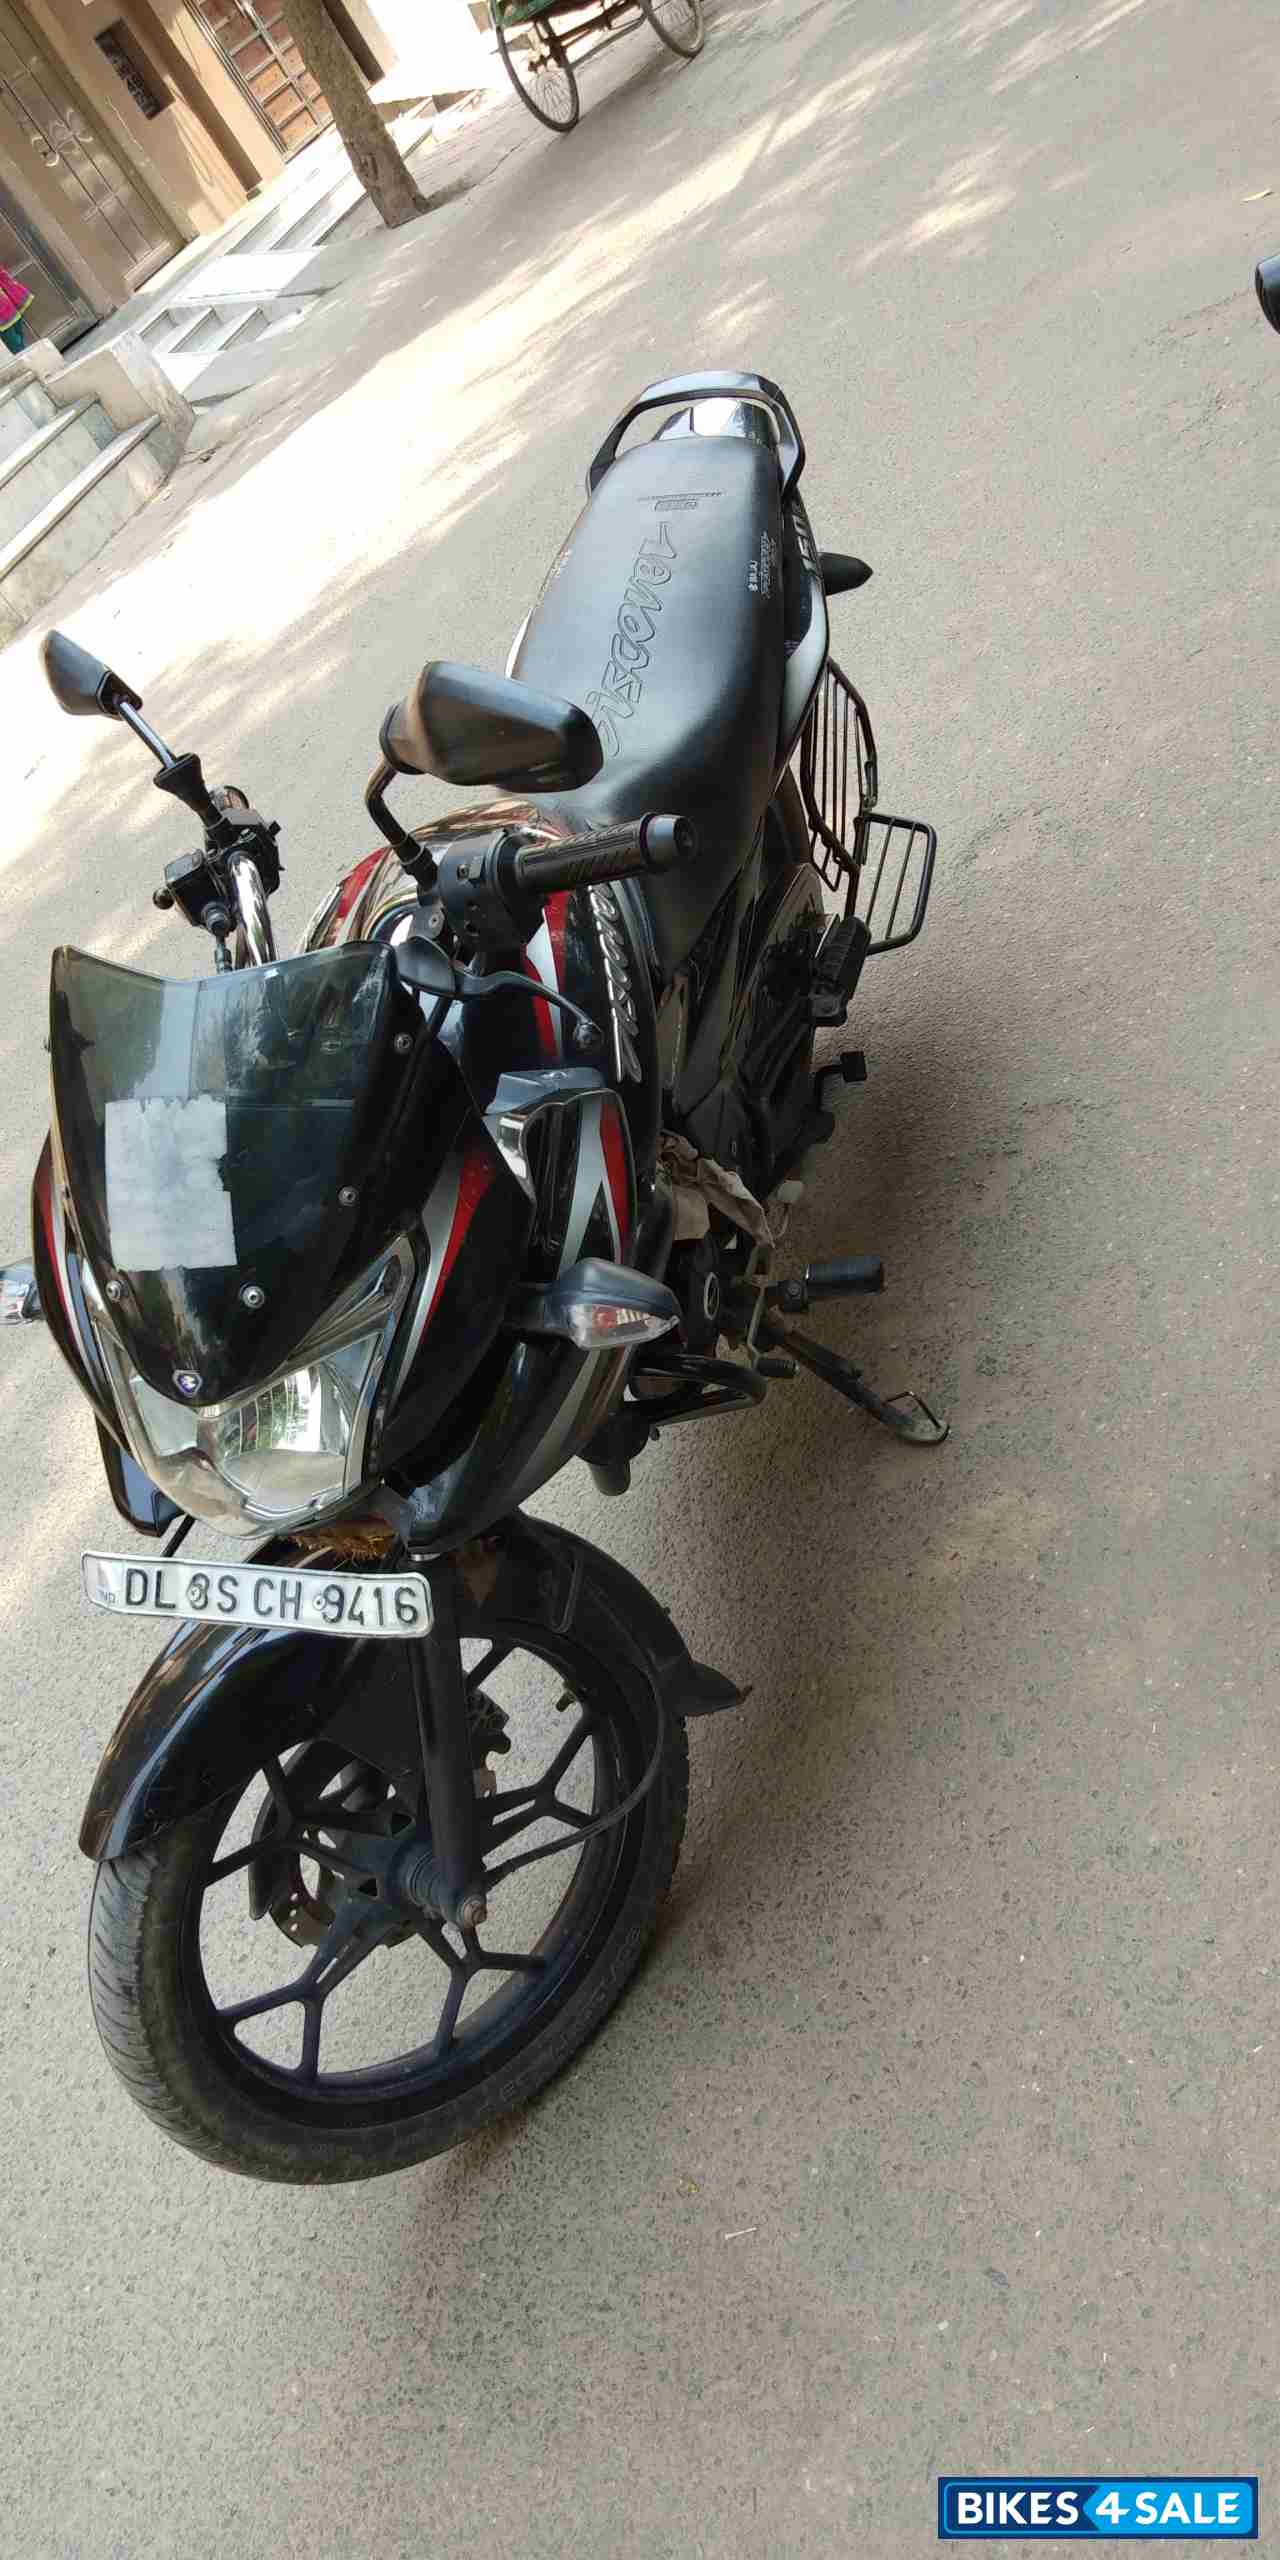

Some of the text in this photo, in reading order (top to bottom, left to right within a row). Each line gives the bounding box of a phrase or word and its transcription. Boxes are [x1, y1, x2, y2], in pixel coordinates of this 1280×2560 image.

[125, 1568, 176, 1609] DL
[254, 1577, 302, 1621] CH
[322, 1583, 418, 1626] 9416
